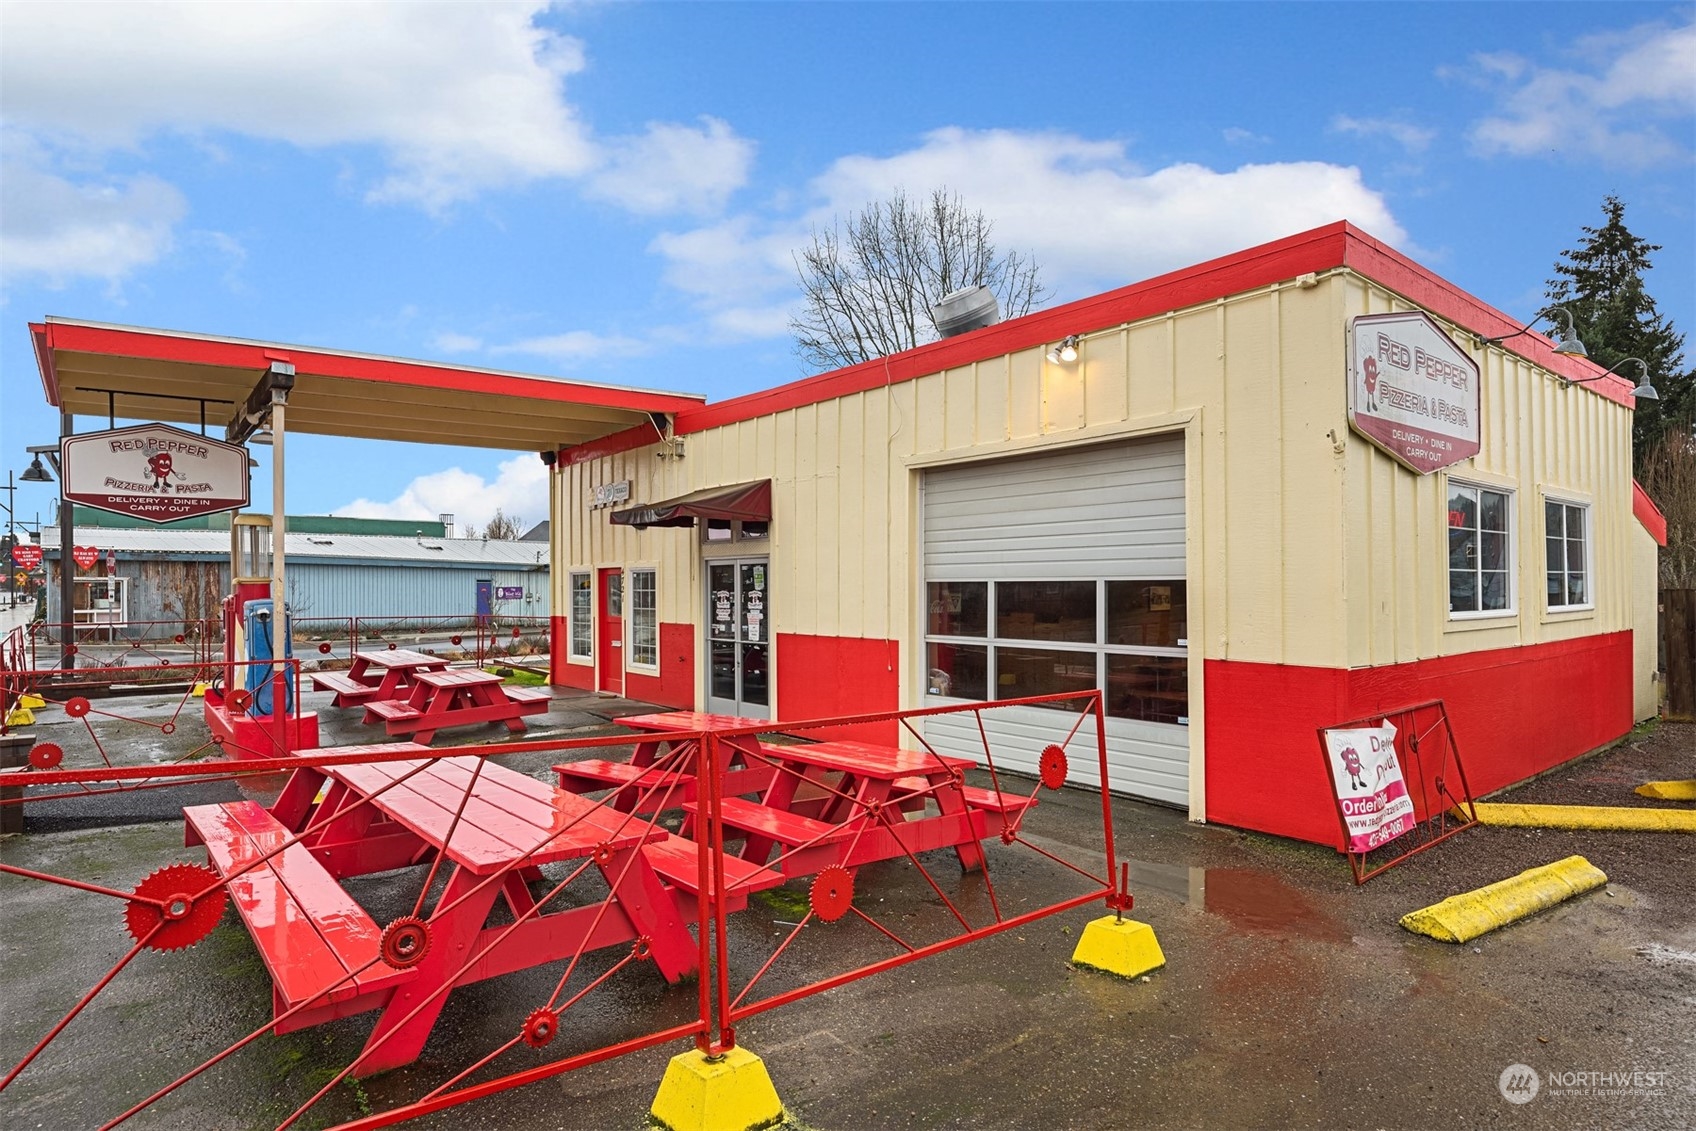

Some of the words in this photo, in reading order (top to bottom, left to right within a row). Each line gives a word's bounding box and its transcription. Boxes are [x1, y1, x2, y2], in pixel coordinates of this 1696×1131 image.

[1377, 331, 1411, 371] RED
[1414, 346, 1468, 392] PEPPER
[1379, 380, 1429, 417] PIZZERIA
[1431, 398, 1438, 419] &
[1438, 399, 1469, 428] PASTA
[109, 439, 145, 453] RED
[146, 437, 209, 459] PEPPER
[1392, 429, 1424, 445] DELIVERY
[1431, 438, 1445, 450] DINE
[1445, 442, 1453, 452] IN
[1406, 446, 1429, 460] CARRY
[1429, 451, 1442, 462] OUT
[104, 477, 157, 494] PIZZERIA
[160, 485, 169, 494] &
[175, 482, 213, 494] PASTA
[108, 496, 160, 505] DELIVERY
[173, 498, 199, 506] DINE
[129, 504, 167, 512] CARRY
